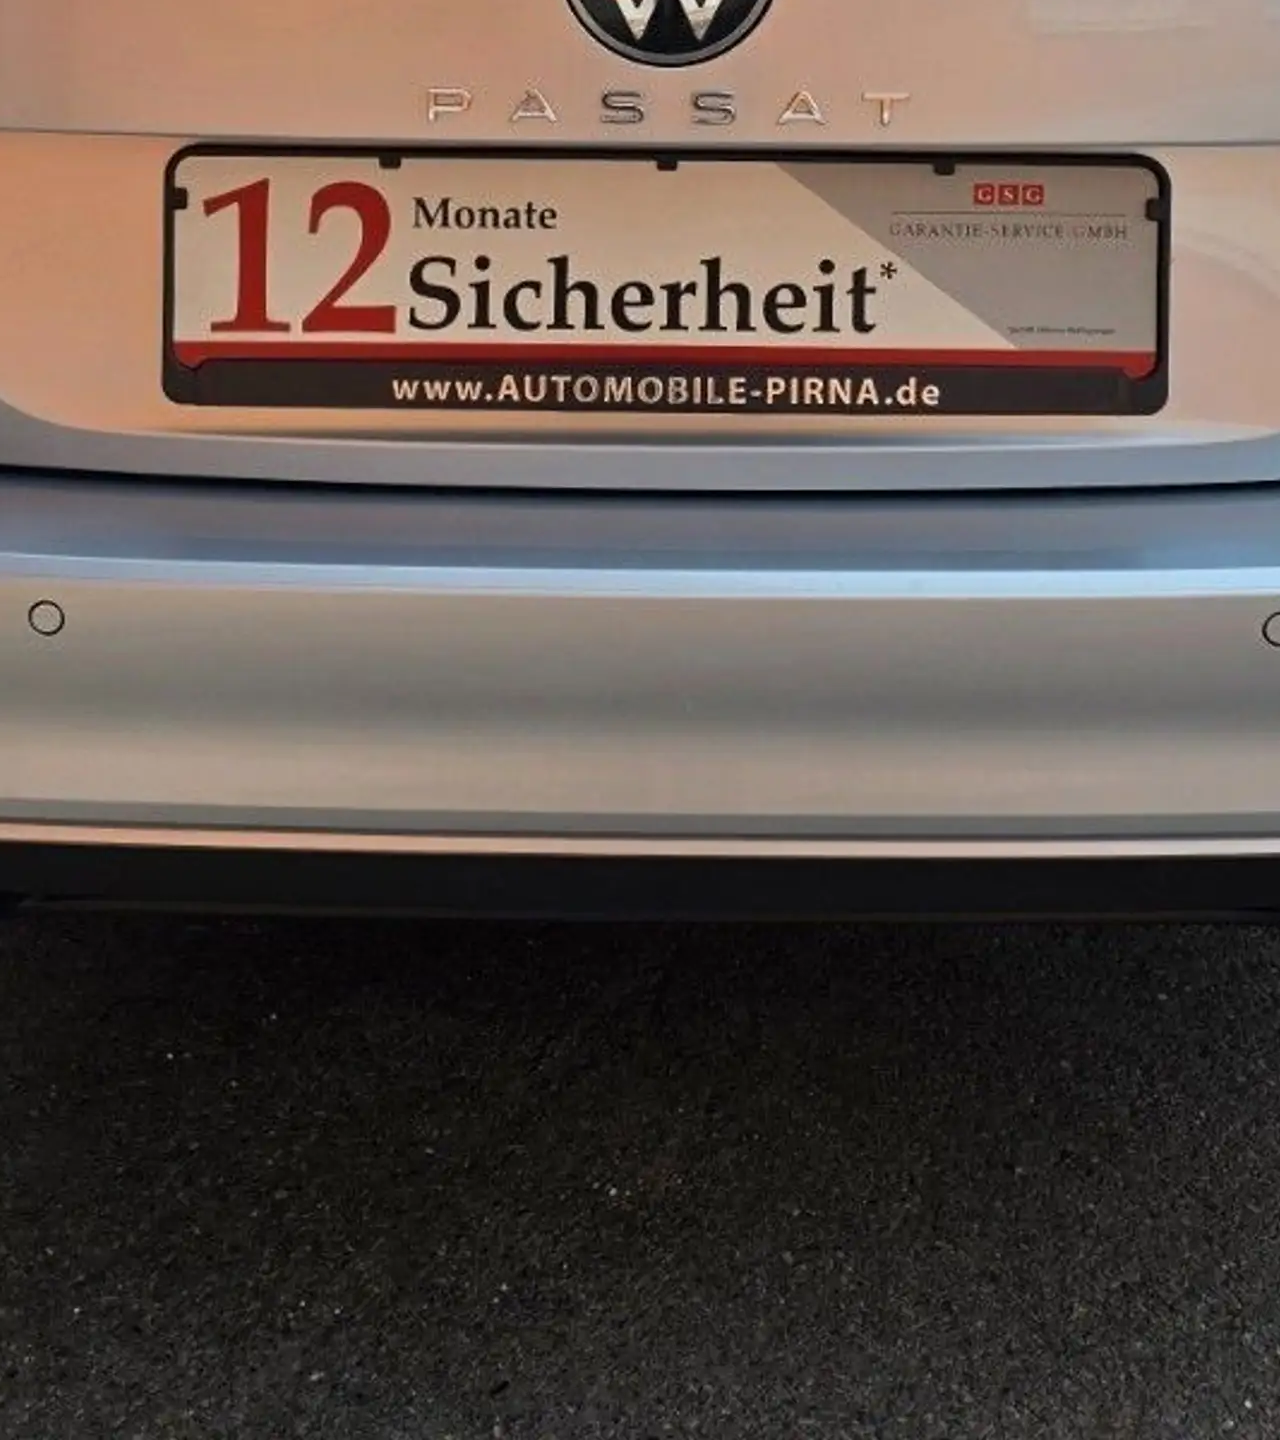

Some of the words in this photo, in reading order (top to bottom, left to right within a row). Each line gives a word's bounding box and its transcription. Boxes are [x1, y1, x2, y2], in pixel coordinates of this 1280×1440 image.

[426, 87, 911, 126] PASSAT
[889, 221, 1064, 239] GARANTIE-SERVICE
[202, 177, 397, 333] 12
[412, 196, 558, 229] Monate
[392, 374, 941, 407] www.AUTOMOBILE-PIRNA.de
